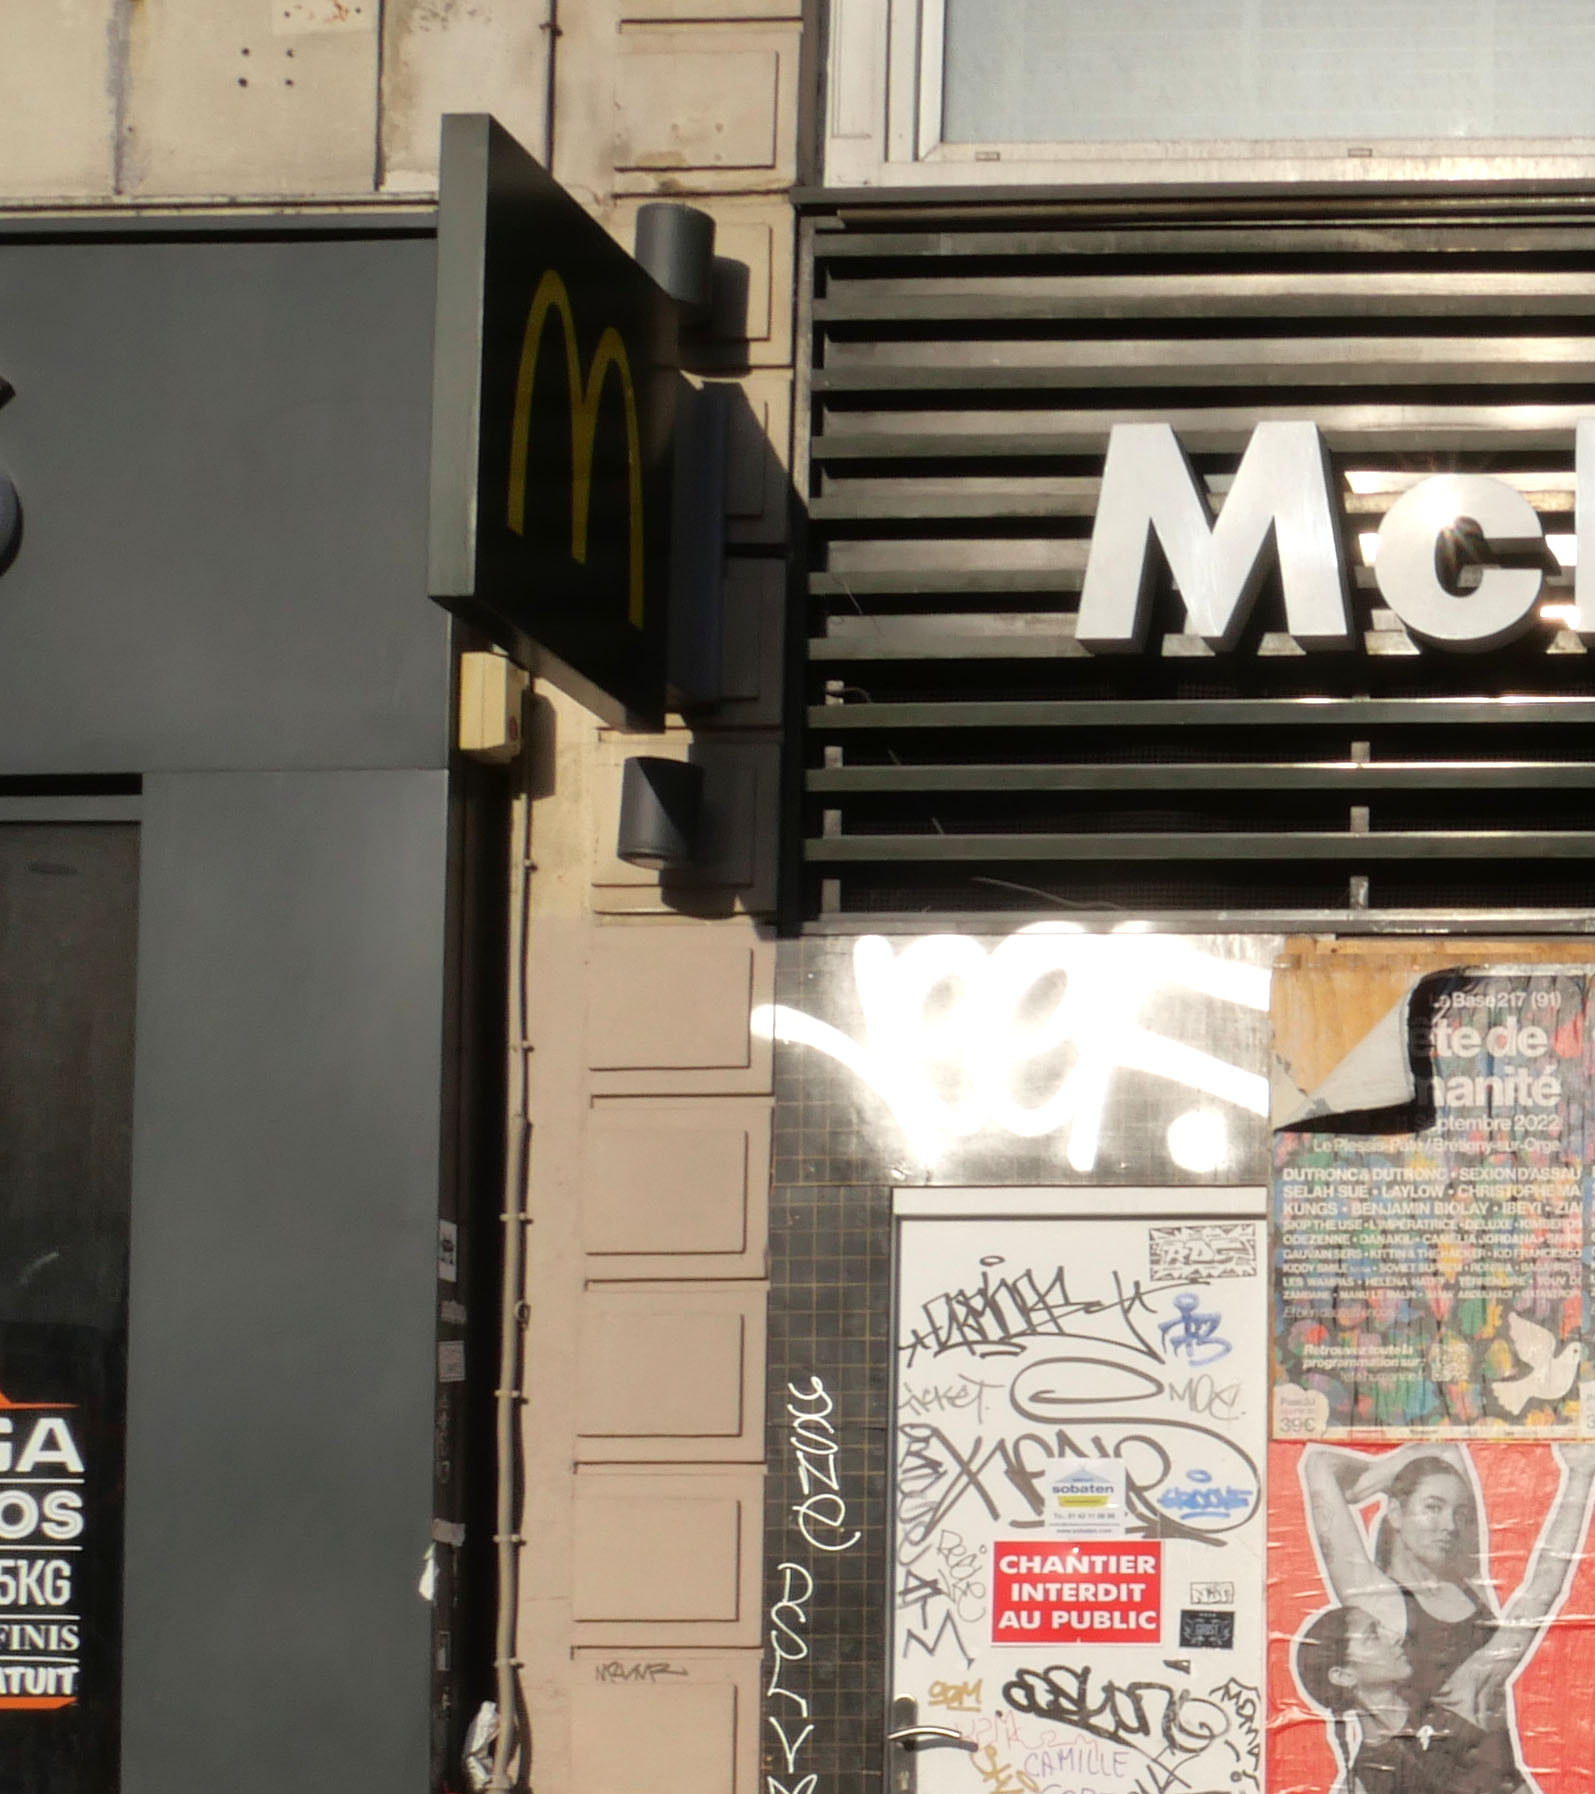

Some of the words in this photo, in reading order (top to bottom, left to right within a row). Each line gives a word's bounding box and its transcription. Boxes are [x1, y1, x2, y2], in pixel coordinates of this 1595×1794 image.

[1052, 1483, 1114, 1495] sobaten
[1000, 1554, 1156, 1575] CHANTIER
[1011, 1583, 1146, 1603] INTERDIT
[999, 1611, 1040, 1630] AU
[1051, 1611, 1158, 1631] PUBLIC
[1024, 1748, 1130, 1778] CAMILLE
